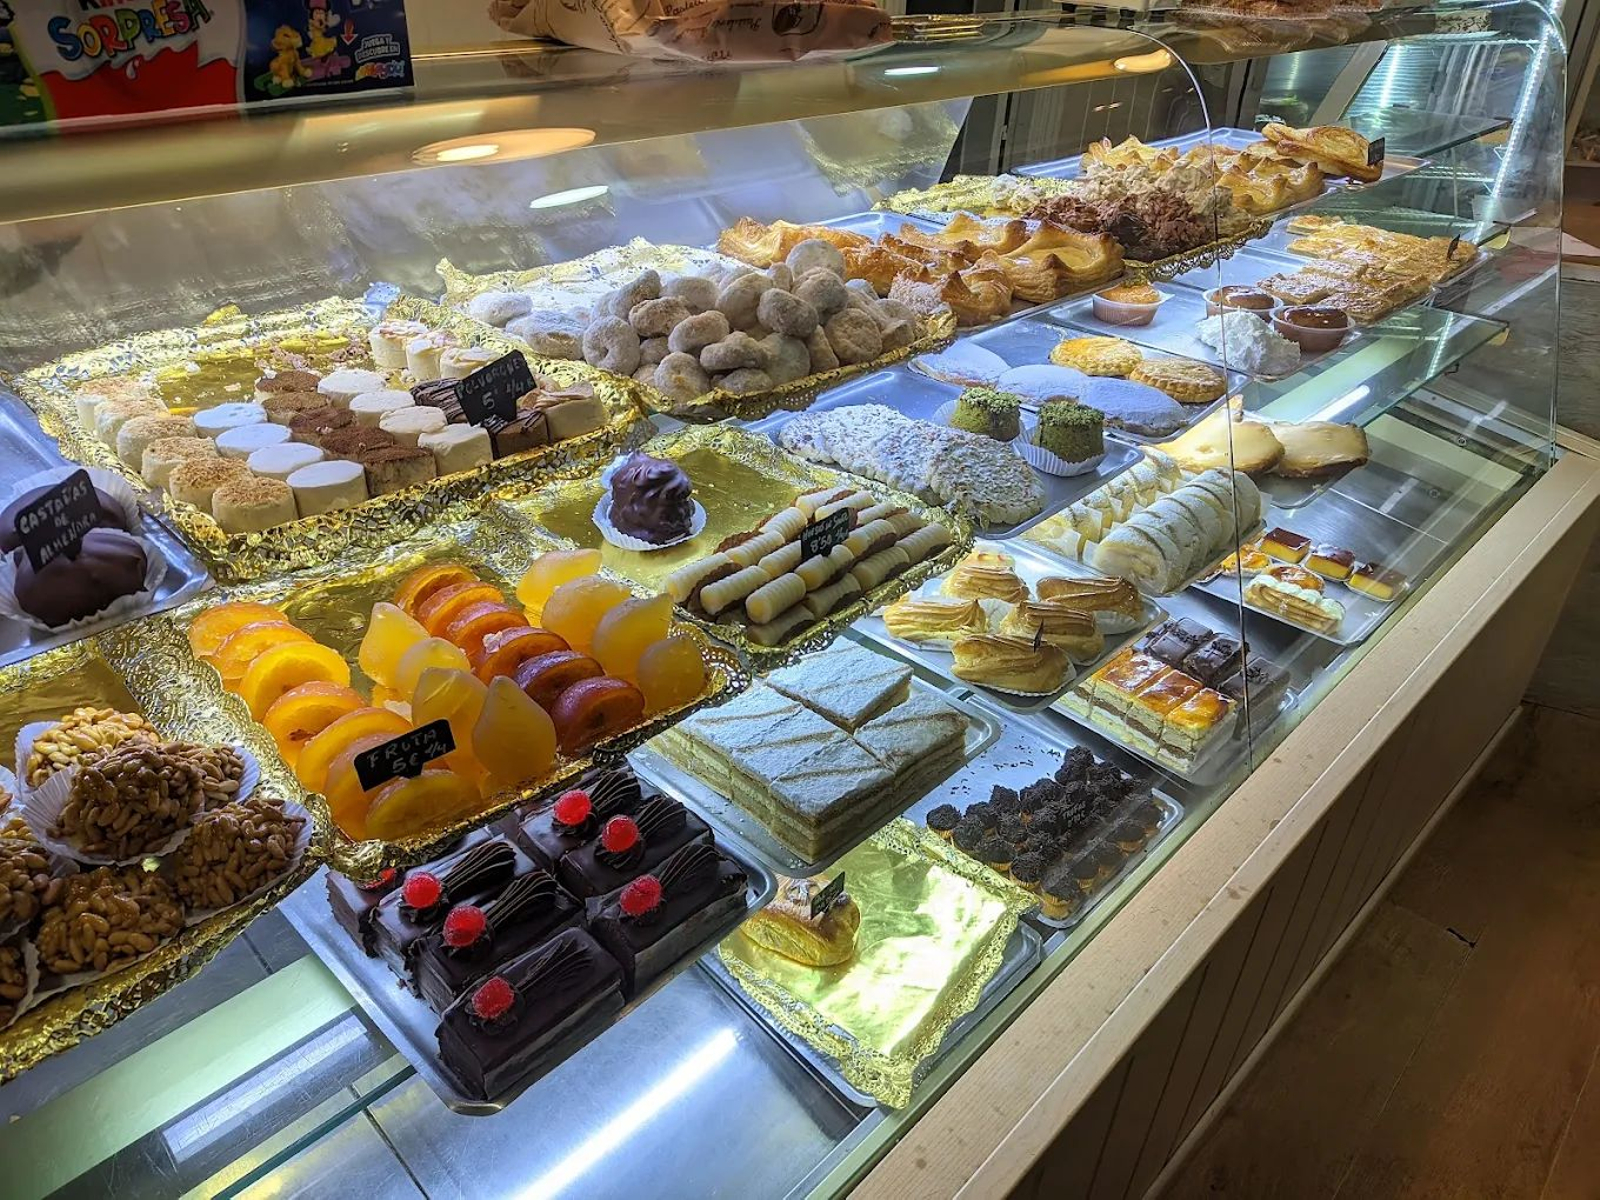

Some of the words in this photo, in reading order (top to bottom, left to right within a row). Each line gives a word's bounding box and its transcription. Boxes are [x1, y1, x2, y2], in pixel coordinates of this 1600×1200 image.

[48, 0, 211, 61] SORPRESA
[19, 480, 88, 535] CASTAÑAS
[54, 512, 69, 528] DE
[39, 512, 97, 565] ALMENDRA
[366, 728, 437, 768] FRUTA
